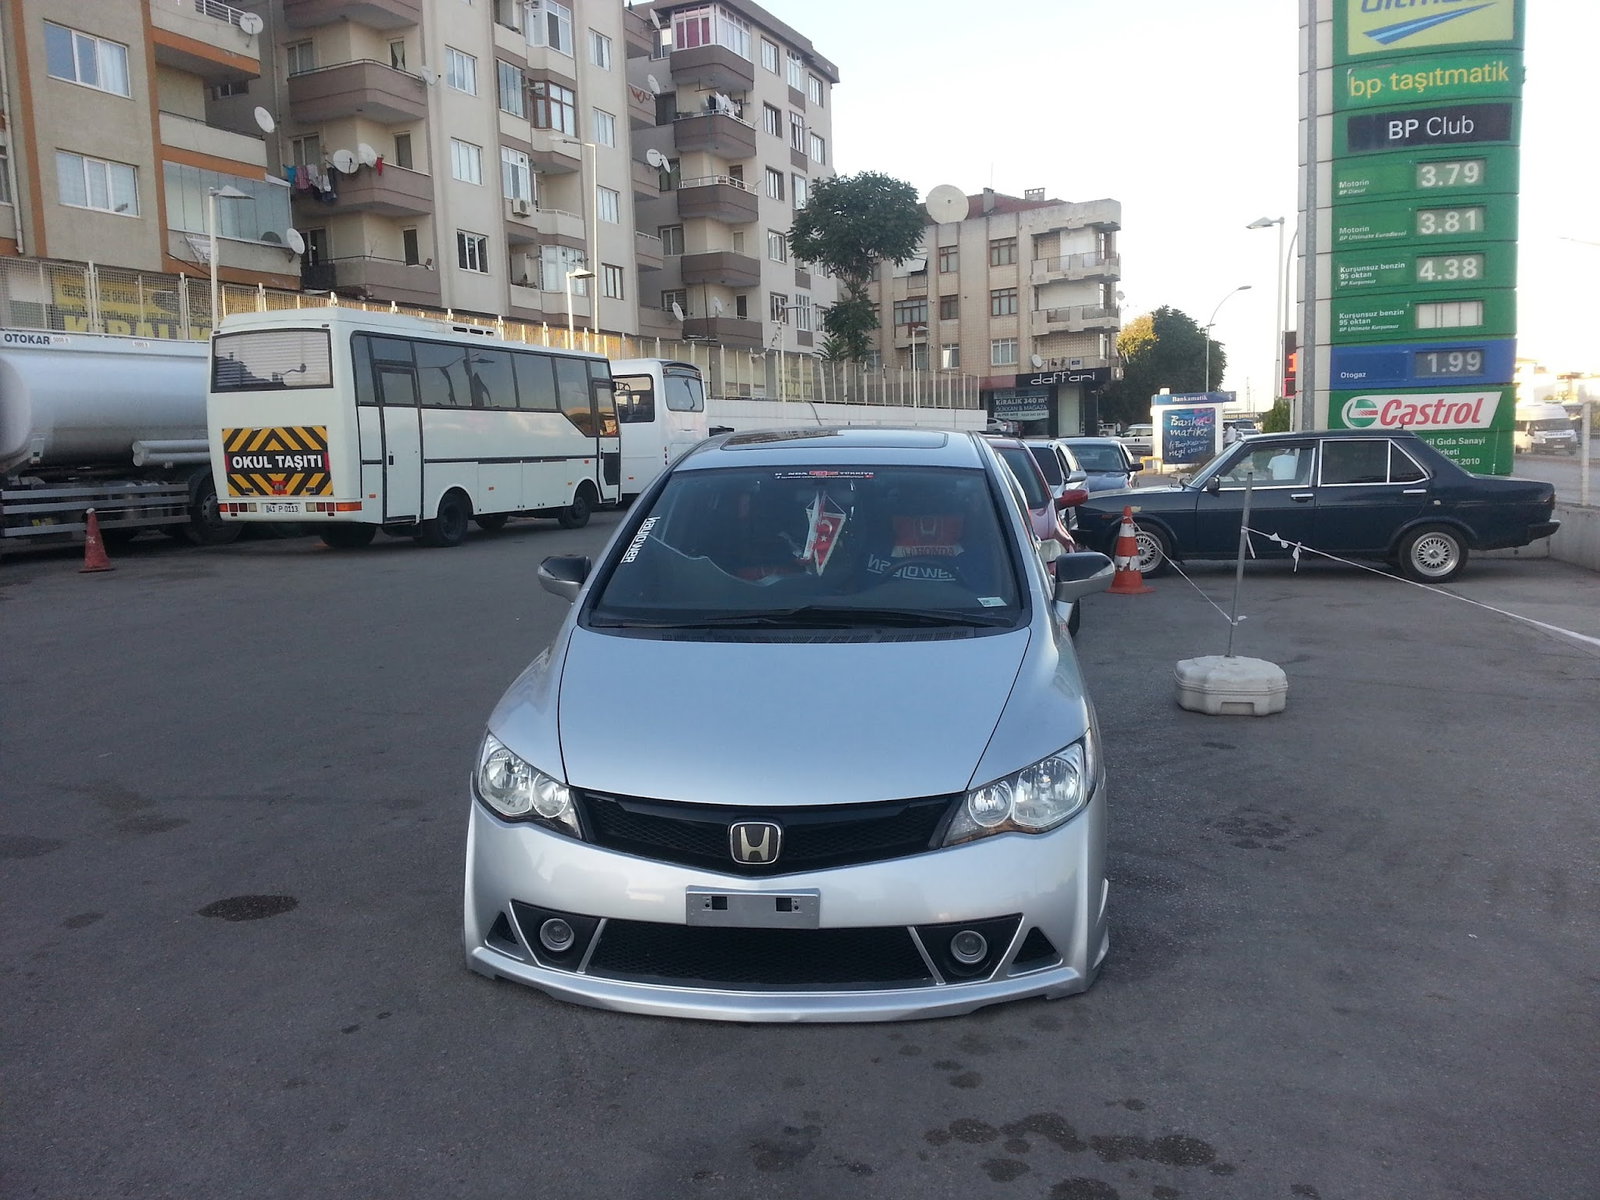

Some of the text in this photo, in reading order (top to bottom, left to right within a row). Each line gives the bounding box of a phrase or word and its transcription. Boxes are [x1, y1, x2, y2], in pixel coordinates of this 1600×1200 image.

[1350, 61, 1509, 98] bp taşıtmatik
[1388, 115, 1474, 140] BP Club
[1421, 161, 1480, 187] 3.79
[1339, 179, 1370, 189] Motorin
[1421, 210, 1476, 234] 3.81
[1339, 226, 1370, 234] Motorin
[1380, 262, 1406, 270] benzin
[1420, 257, 1477, 280] 4.38
[1379, 309, 1405, 317] benzin
[4, 333, 50, 345] OTOKAR
[1427, 351, 1482, 373] 1.99
[1030, 371, 1096, 385] daffari
[1340, 371, 1367, 380] Otogaz
[1172, 394, 1208, 402] Bankamatik
[1380, 397, 1484, 427] Castrol
[1436, 437, 1457, 445] Gıda
[1458, 437, 1486, 446] Sanayi
[232, 454, 322, 471] OKUL TAŞITI
